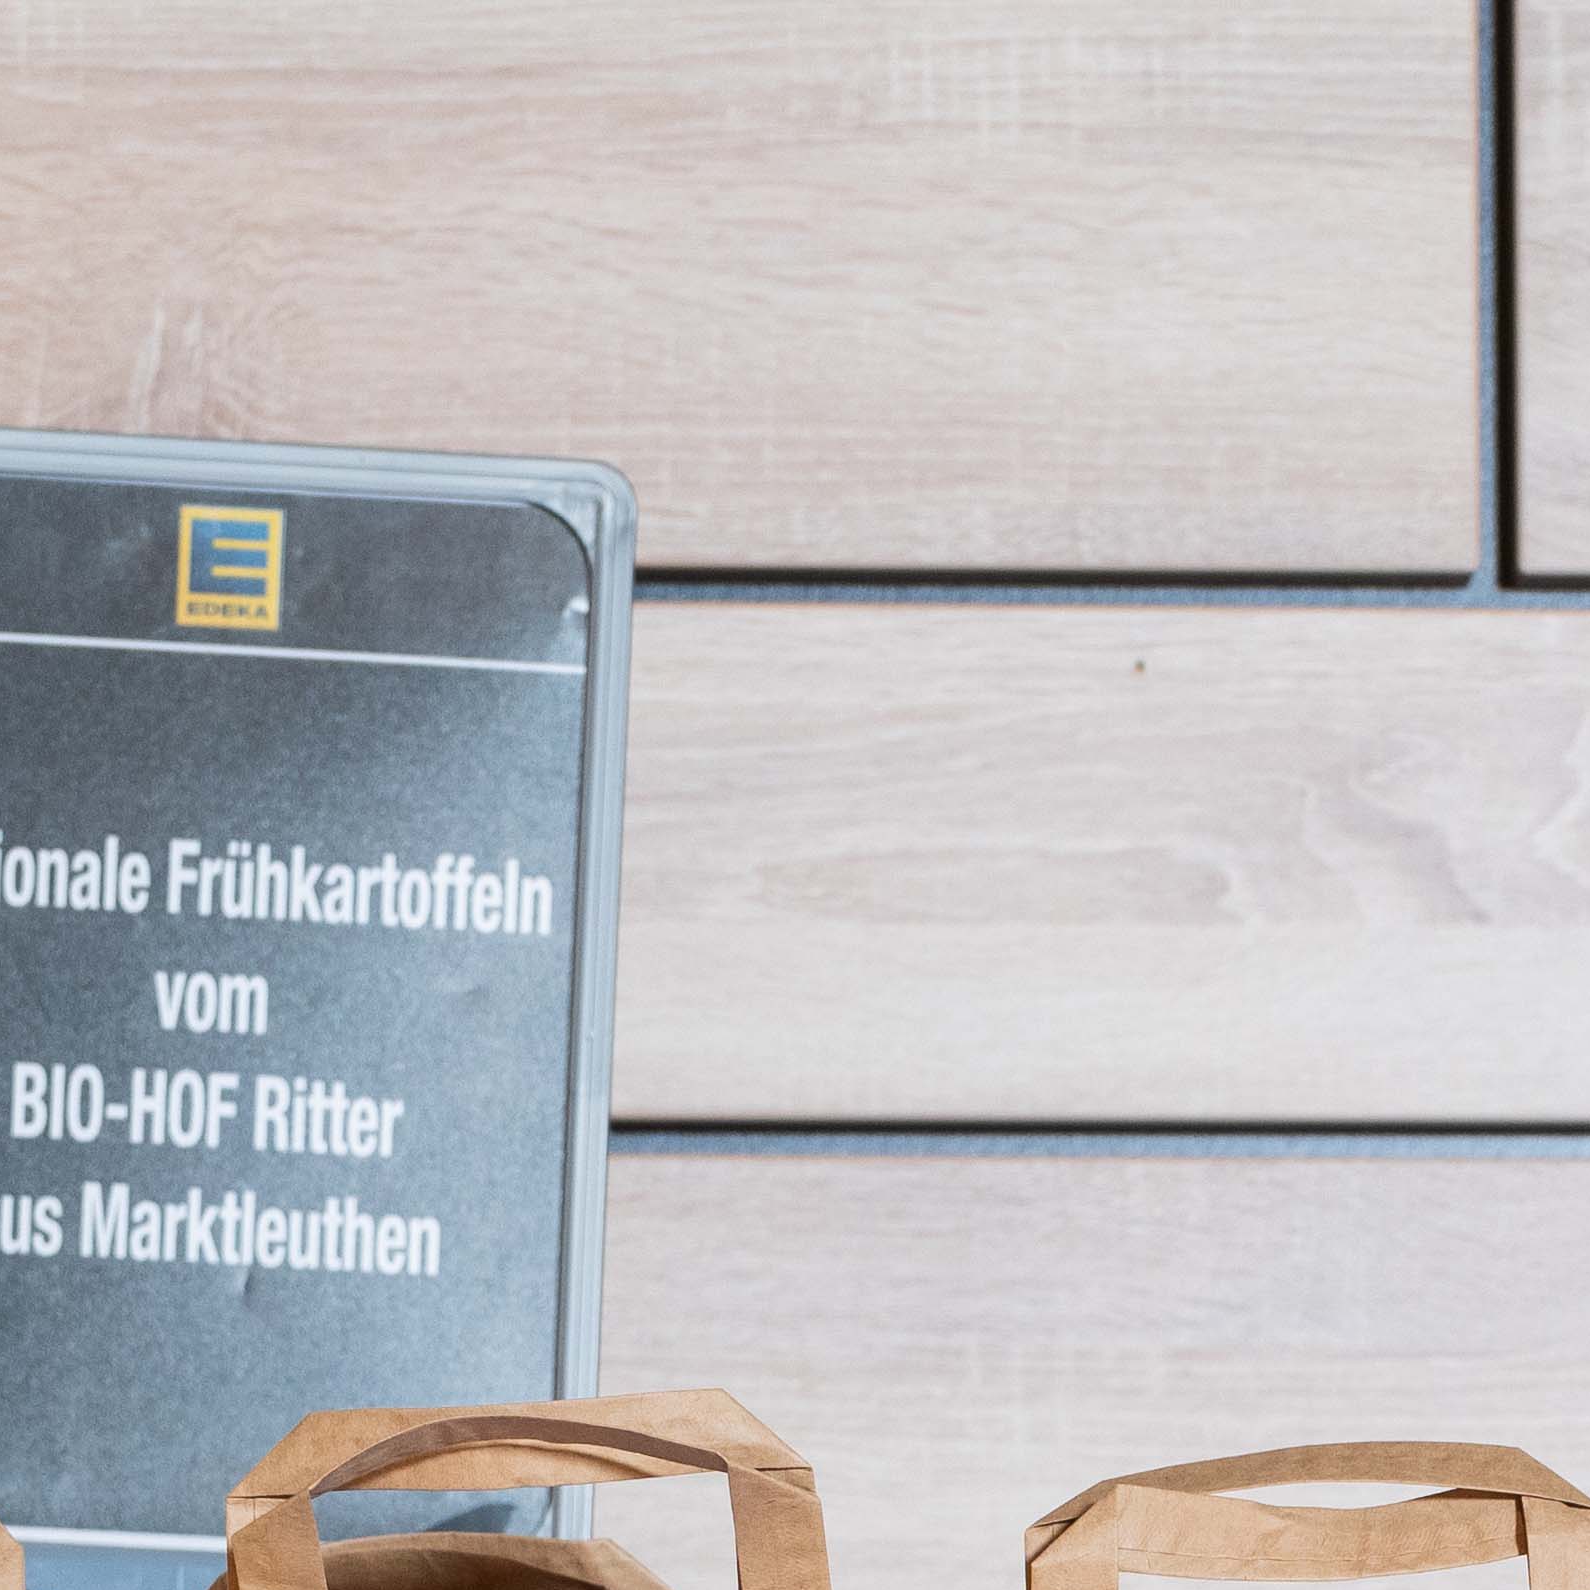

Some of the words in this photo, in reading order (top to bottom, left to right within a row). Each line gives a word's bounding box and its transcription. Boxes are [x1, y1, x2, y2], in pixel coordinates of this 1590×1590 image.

[187, 602, 268, 617] EDEKA
[166, 838, 555, 938] Frühkartoffeln
[155, 970, 269, 1035] vom
[10, 1062, 239, 1148] BIO-HOF
[254, 1073, 405, 1159] Ritter
[79, 1181, 442, 1277] Marktleuthen
